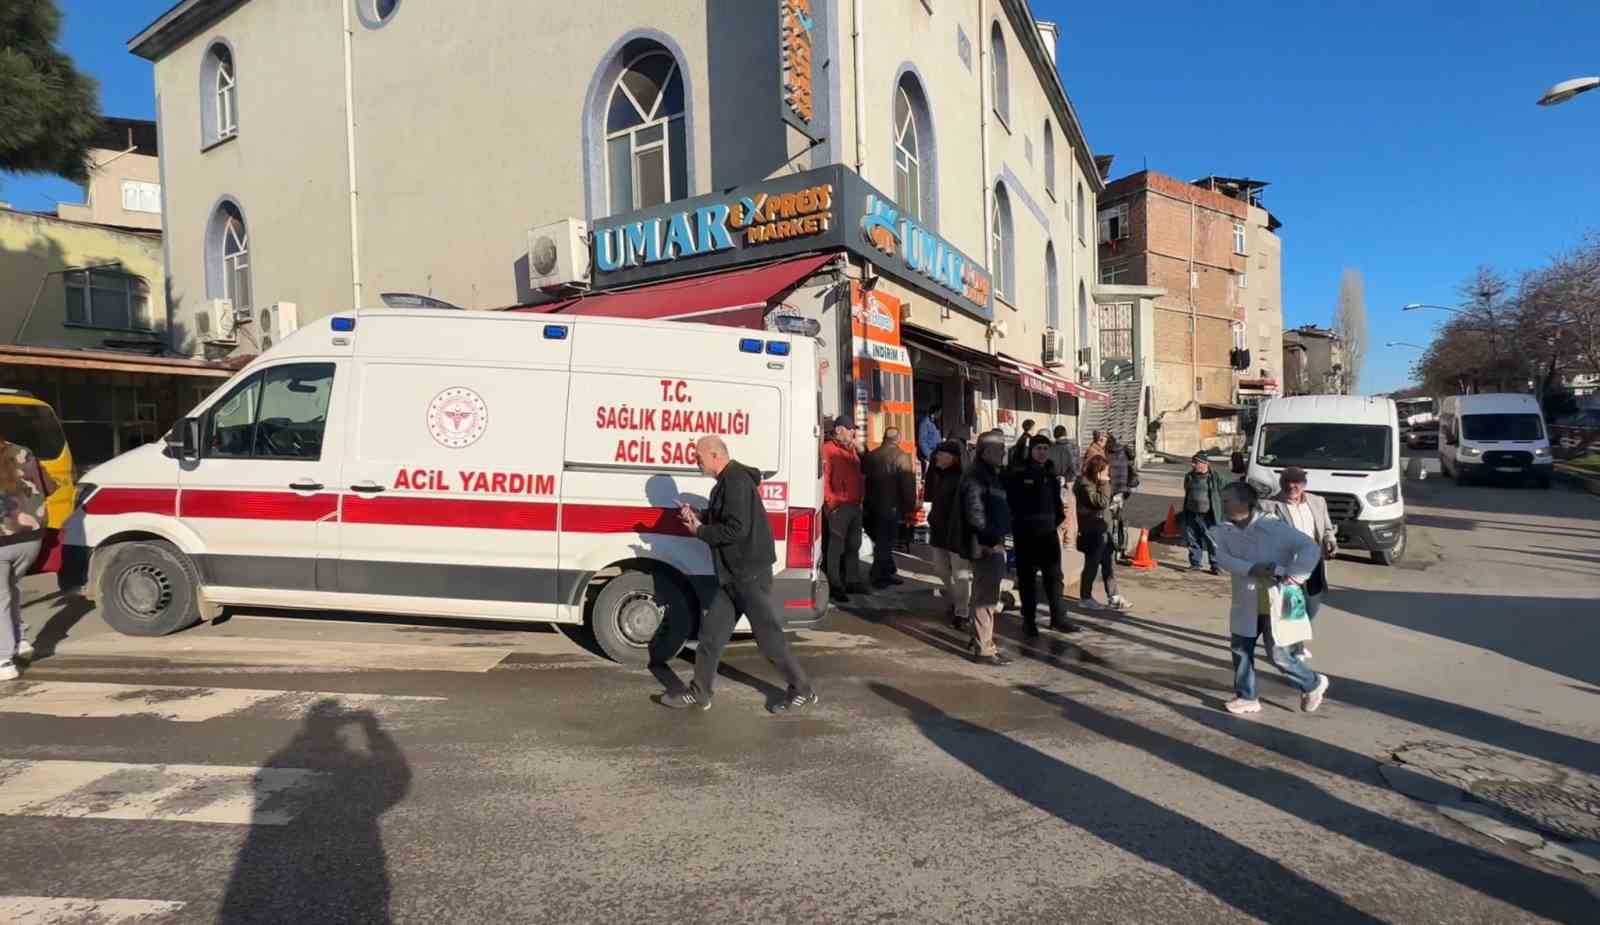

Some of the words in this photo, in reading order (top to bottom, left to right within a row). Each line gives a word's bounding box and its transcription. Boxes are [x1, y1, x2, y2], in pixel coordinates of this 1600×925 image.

[596, 204, 736, 272] UMAR
[747, 212, 832, 244] MARKET
[660, 379, 692, 402] T.C.
[596, 404, 657, 432] SAĞLIK
[660, 408, 750, 435] BAKANLIĞI
[614, 436, 656, 463] ACİL
[661, 437, 698, 465] SAĞ
[458, 471, 555, 495] YARDIM
[763, 484, 784, 499] 112
